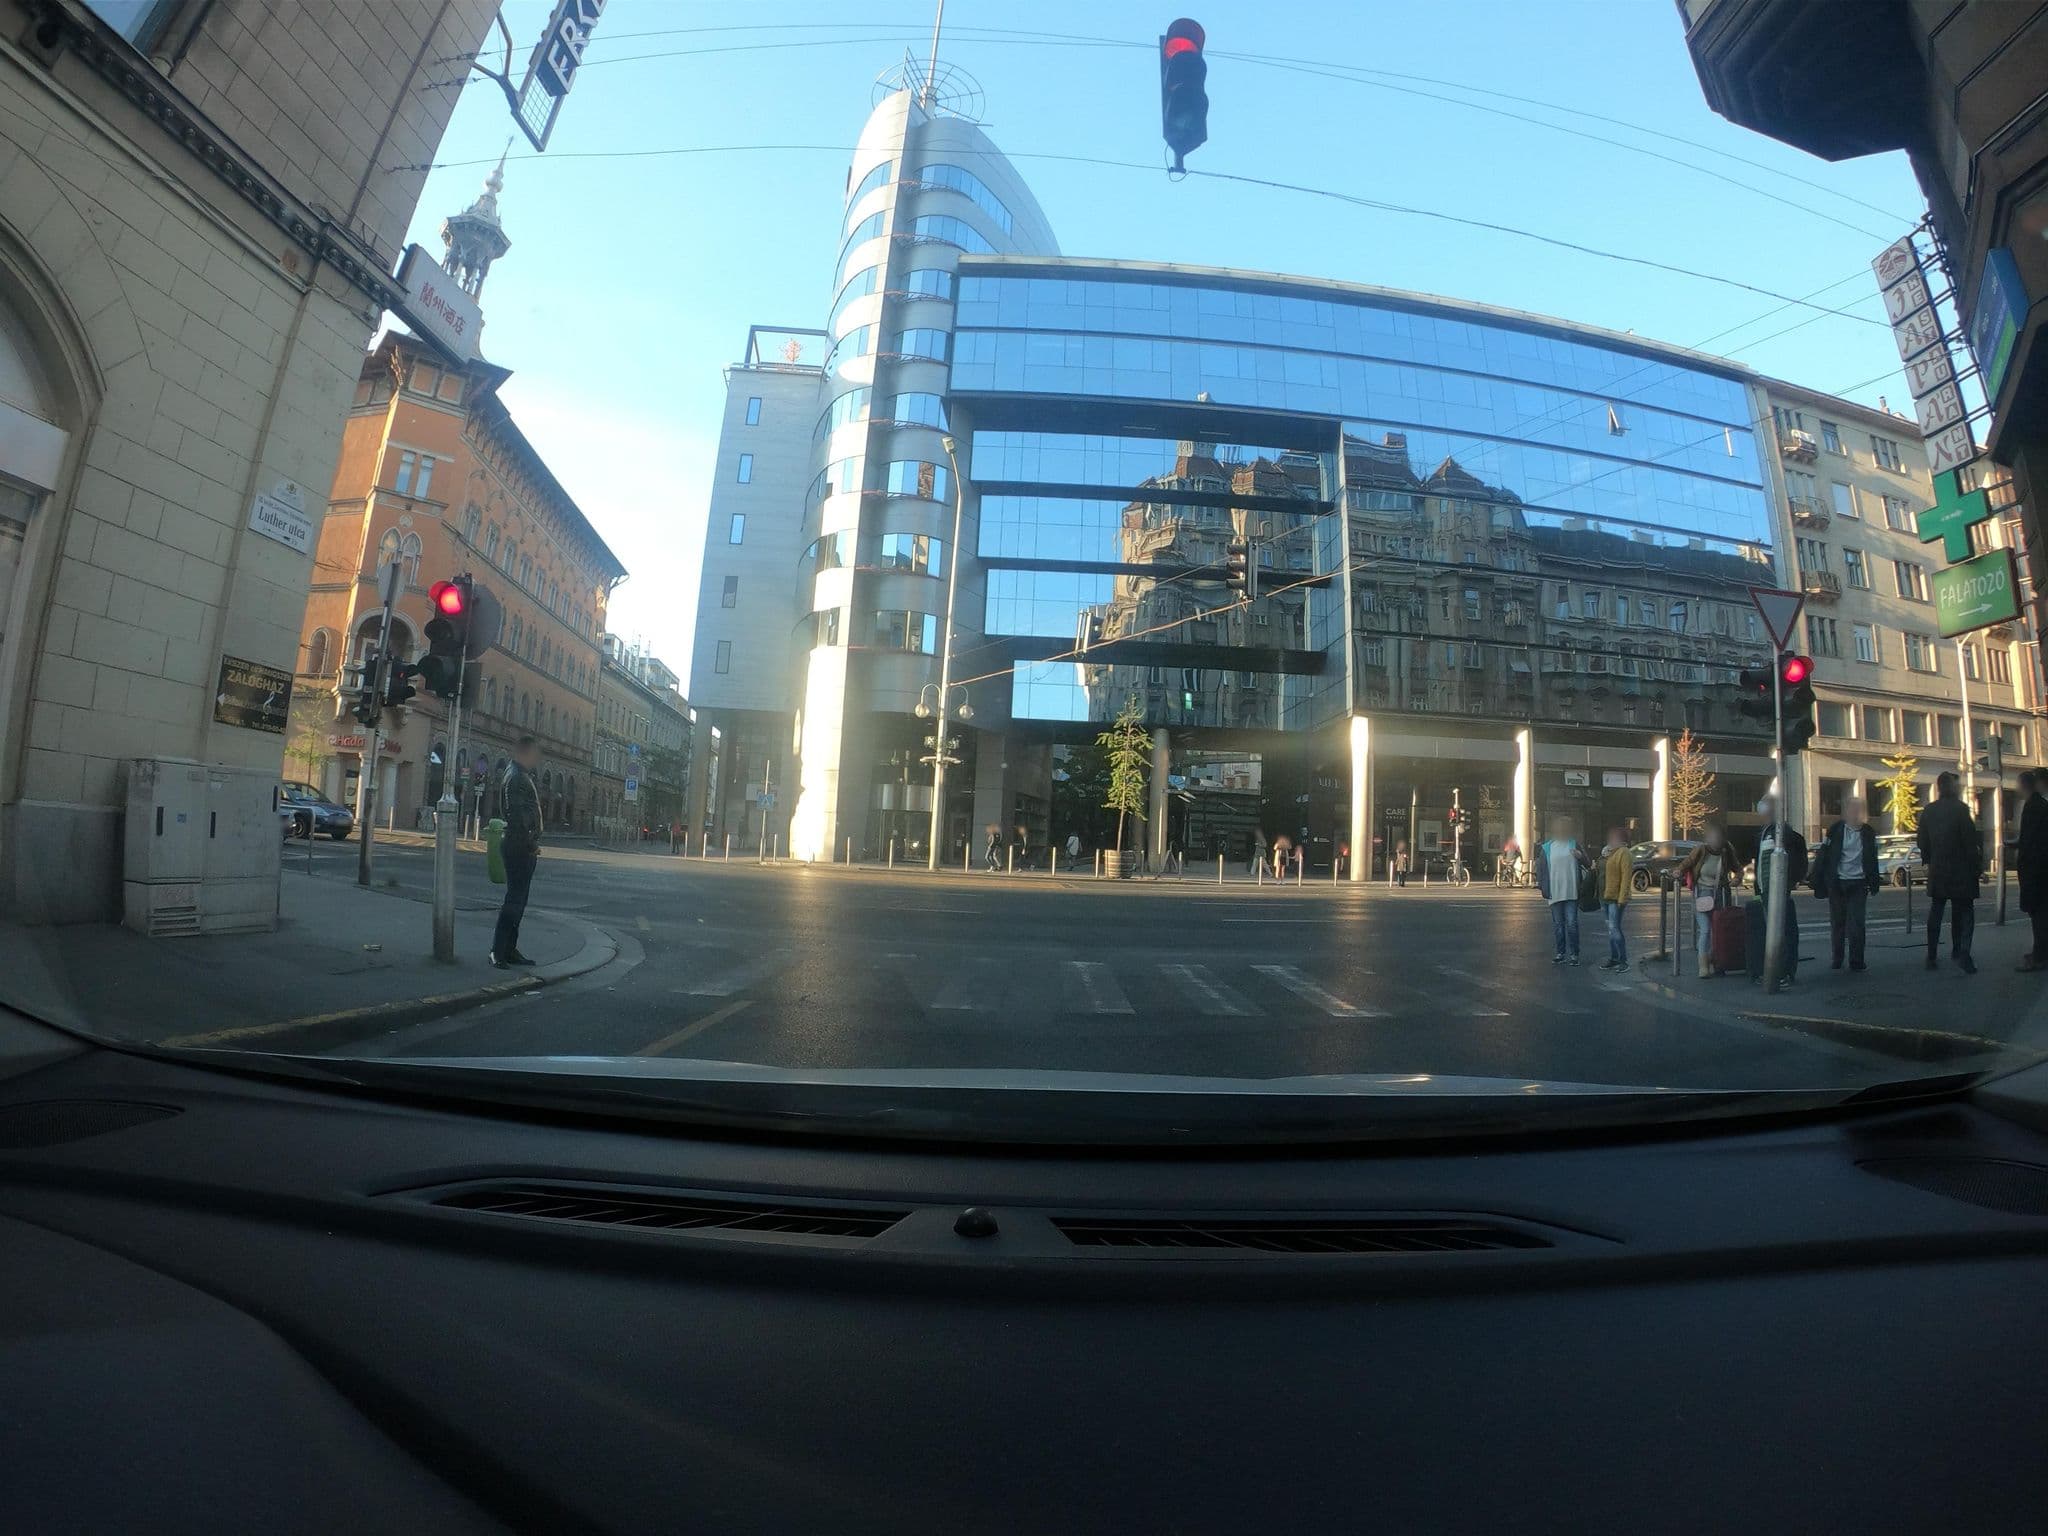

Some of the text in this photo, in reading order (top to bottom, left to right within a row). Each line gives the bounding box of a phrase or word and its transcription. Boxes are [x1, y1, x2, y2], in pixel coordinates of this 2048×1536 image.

[258, 506, 287, 531] Luther
[288, 523, 305, 541] utca
[1940, 567, 2005, 609] FALATOZÓ
